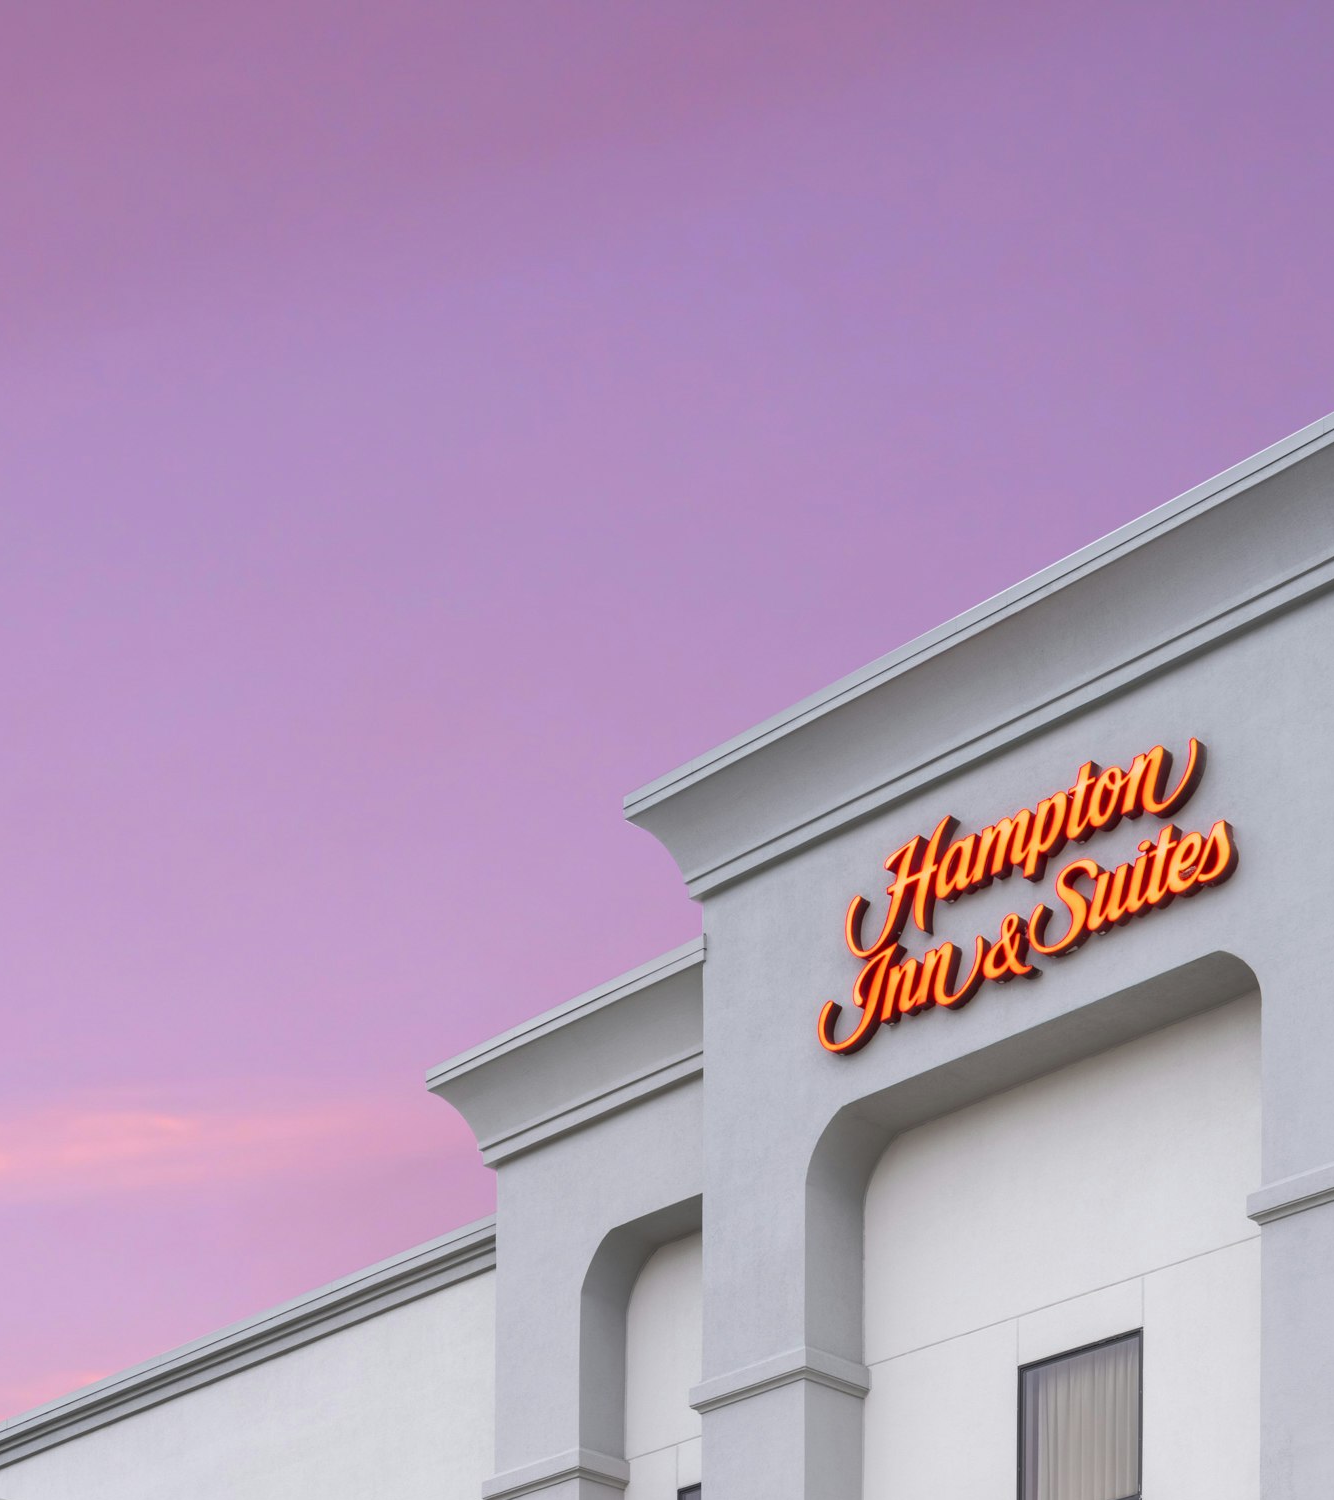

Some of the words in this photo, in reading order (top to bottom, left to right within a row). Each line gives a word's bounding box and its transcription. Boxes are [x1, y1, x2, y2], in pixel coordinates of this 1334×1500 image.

[817, 934, 994, 1056] Inn
[982, 913, 1043, 983] &
[1028, 820, 1239, 958] Suites
[845, 737, 1208, 959] Hampton
